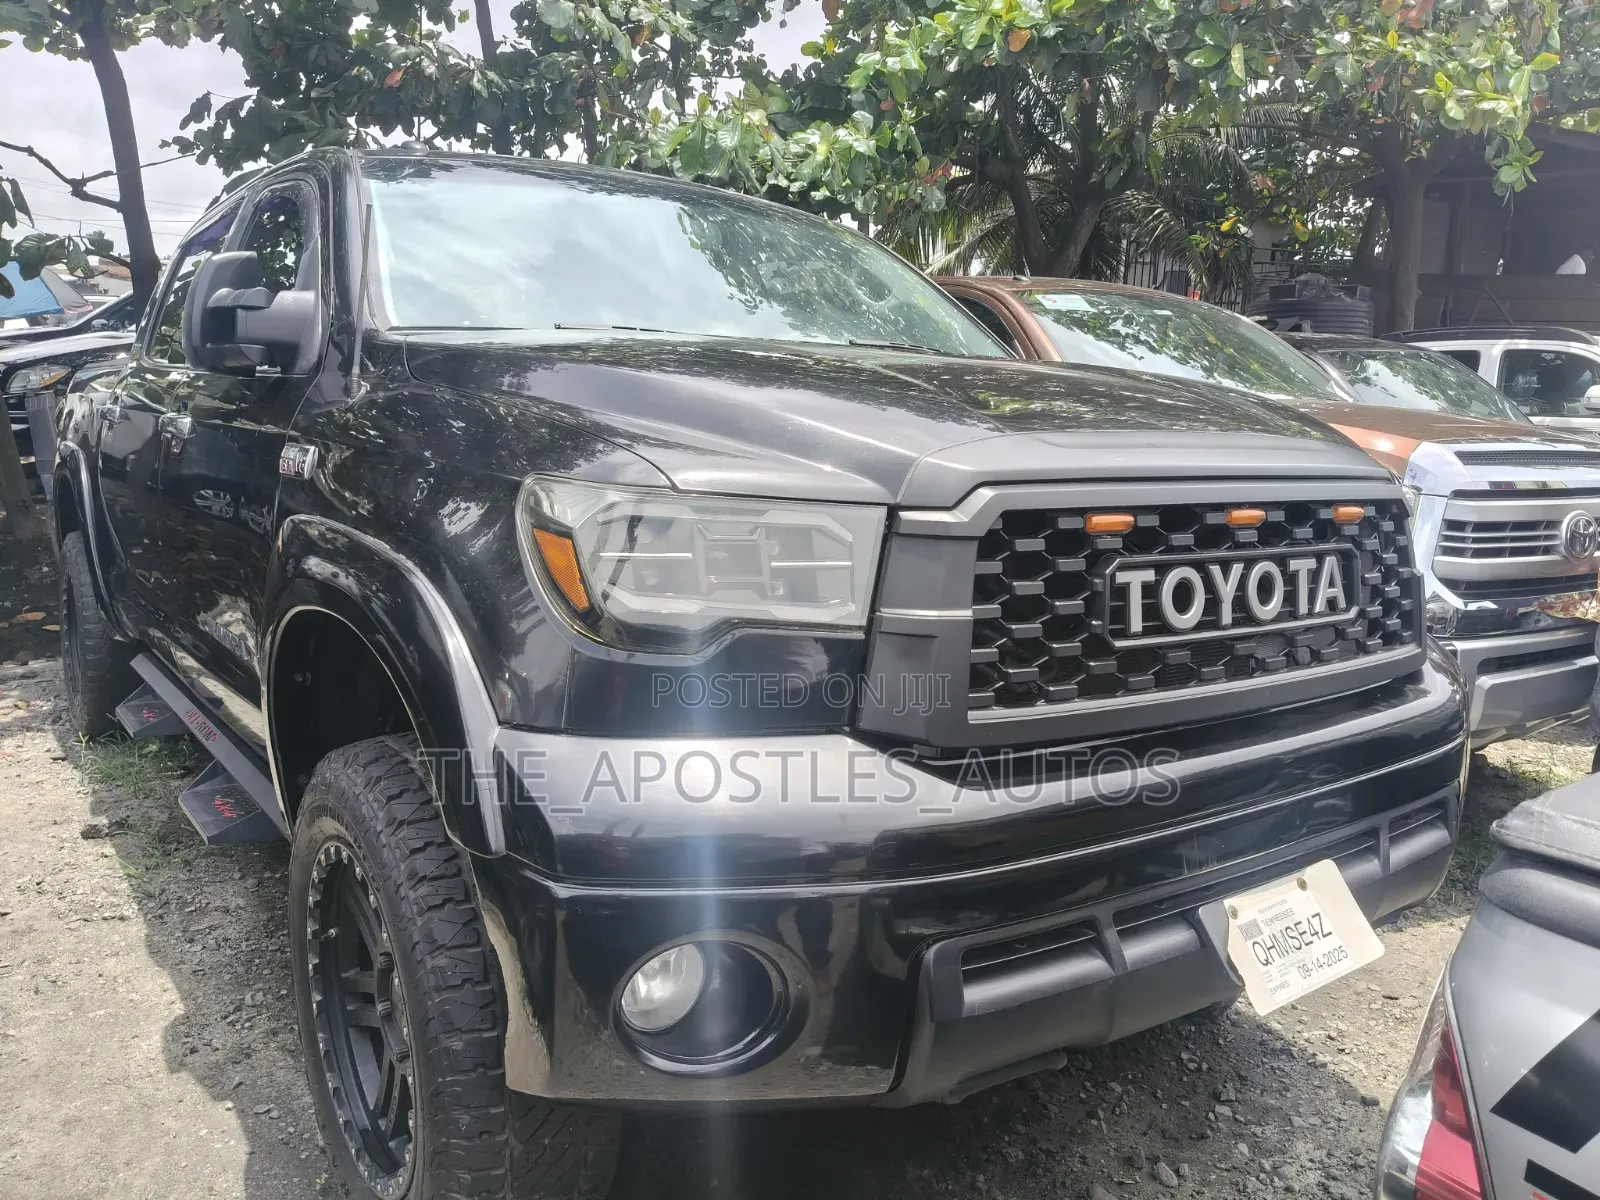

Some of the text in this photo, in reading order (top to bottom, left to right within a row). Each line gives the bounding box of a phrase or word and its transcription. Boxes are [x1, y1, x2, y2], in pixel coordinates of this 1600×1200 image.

[1114, 555, 1347, 636] TOYOTA
[1252, 912, 1333, 967] QHMSE4Z
[1261, 907, 1296, 928] TENNESSEE
[1297, 945, 1349, 980] 09-14-2025
